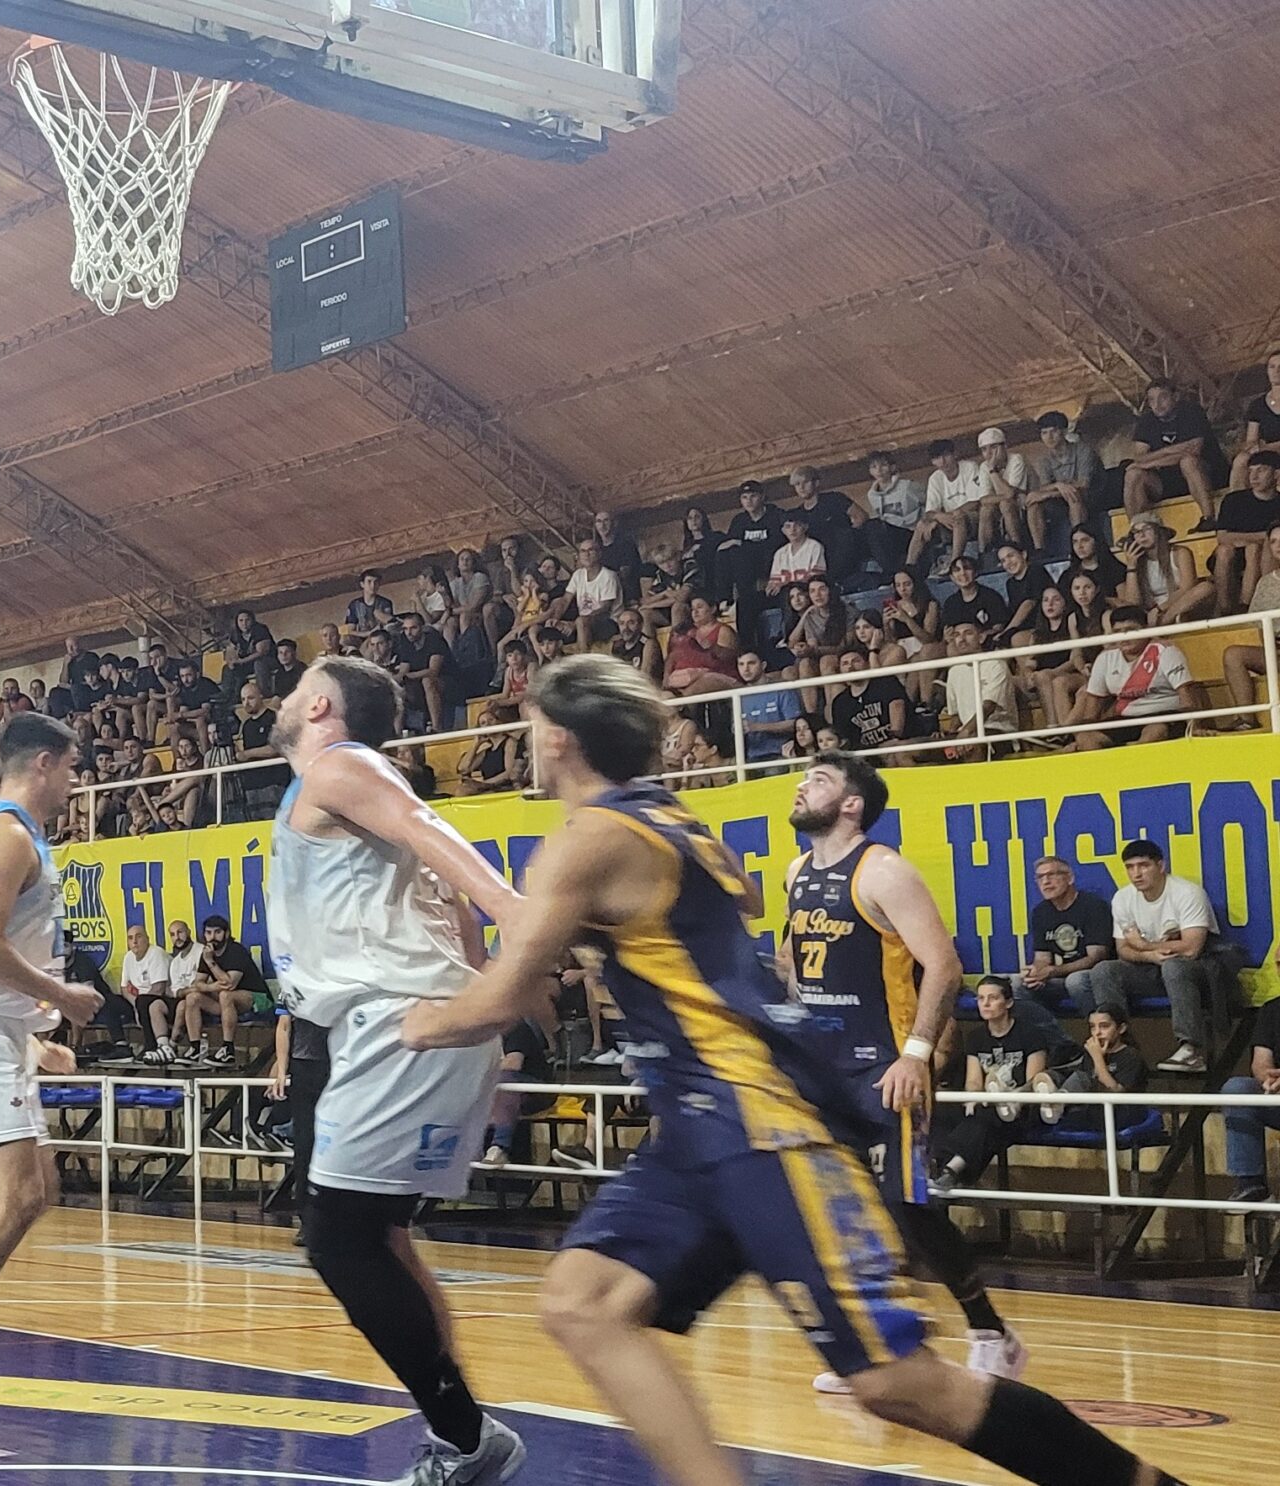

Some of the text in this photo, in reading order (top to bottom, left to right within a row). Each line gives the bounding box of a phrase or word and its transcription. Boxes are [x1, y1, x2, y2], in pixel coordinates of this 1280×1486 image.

[320, 214, 342, 229] TIEMPO
[370, 218, 390, 231] VISITA
[276, 256, 295, 269] LOCAL
[945, 779, 1280, 974] HISTO
[808, 908, 855, 941] Boys
[93, 1393, 165, 1405] de
[184, 1401, 372, 1424] Banco
